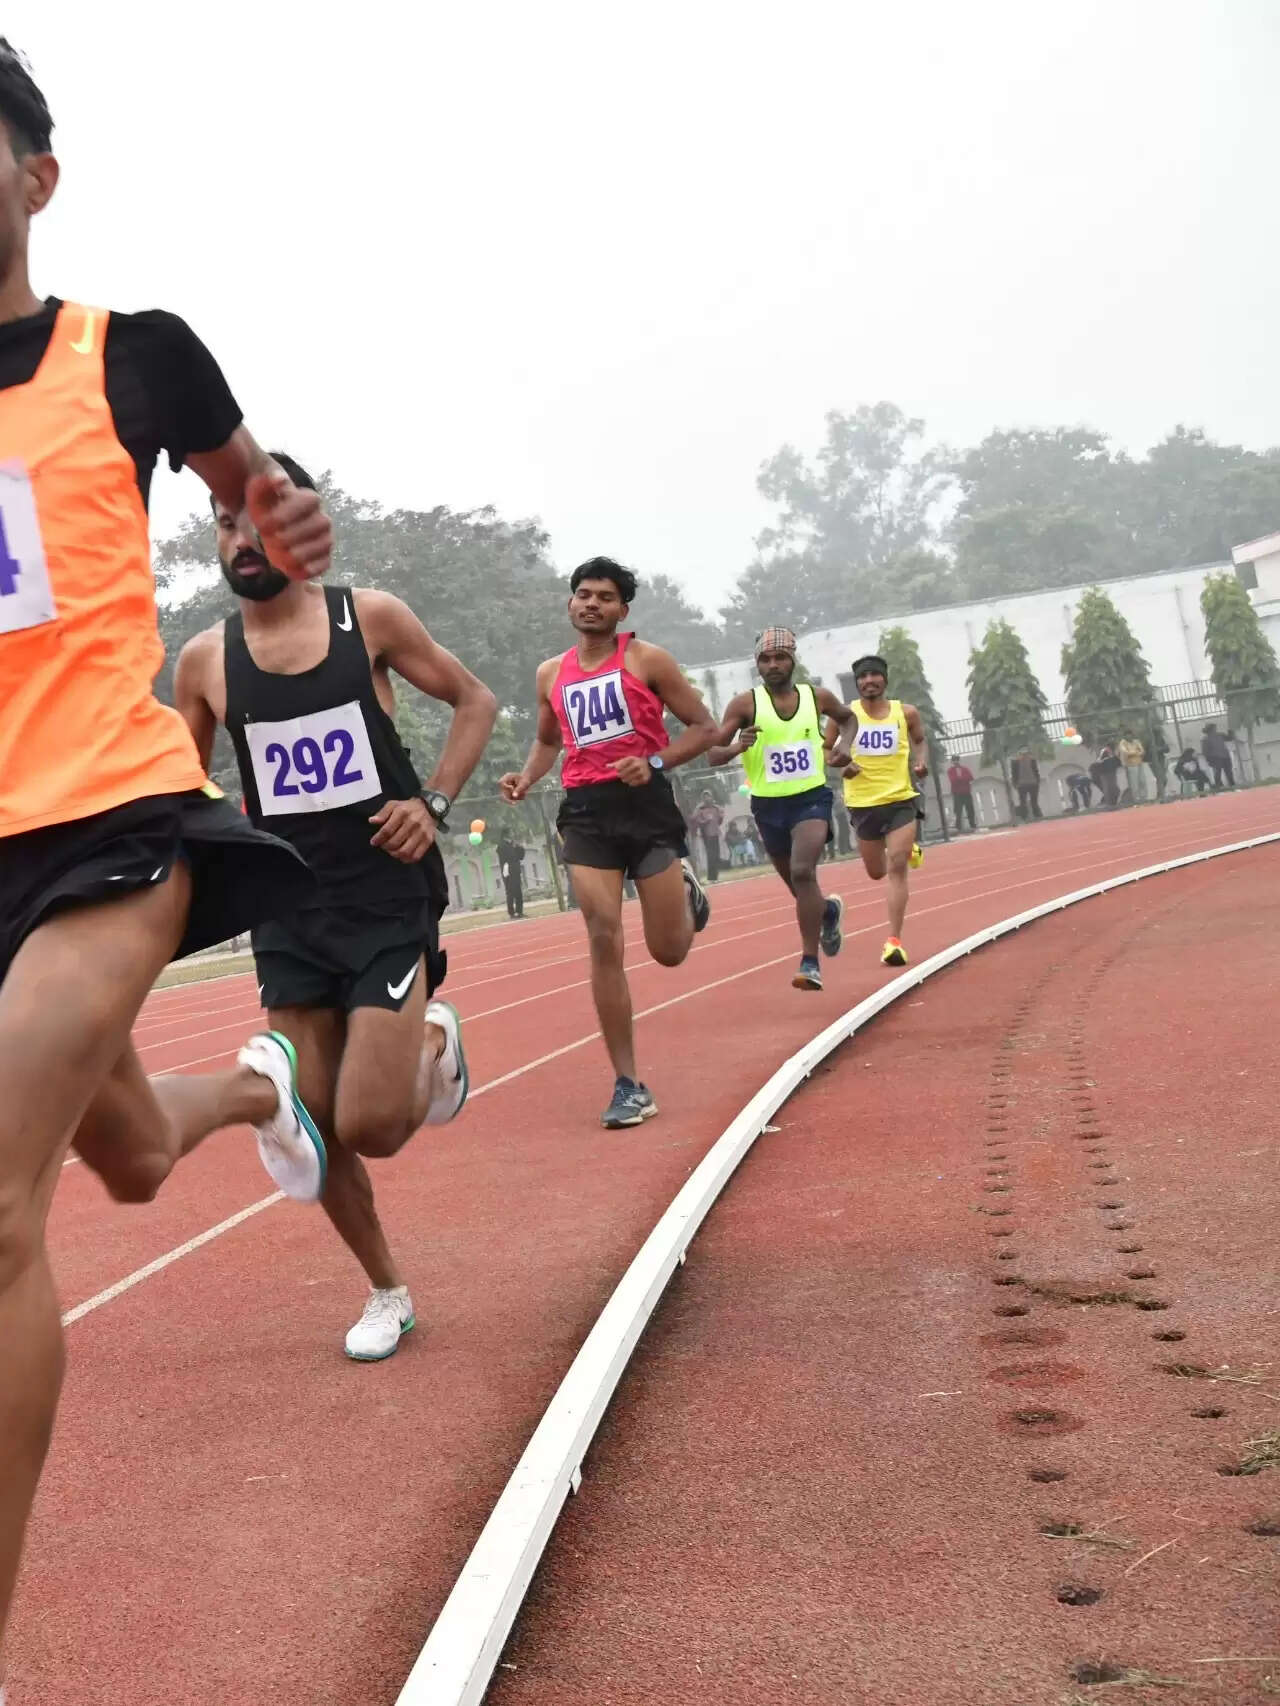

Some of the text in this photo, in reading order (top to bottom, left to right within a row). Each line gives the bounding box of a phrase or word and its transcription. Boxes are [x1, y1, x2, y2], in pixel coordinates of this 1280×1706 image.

[570, 681, 625, 737] 244
[858, 730, 894, 749] 405
[265, 729, 364, 797] 292
[770, 748, 810, 775] 358
